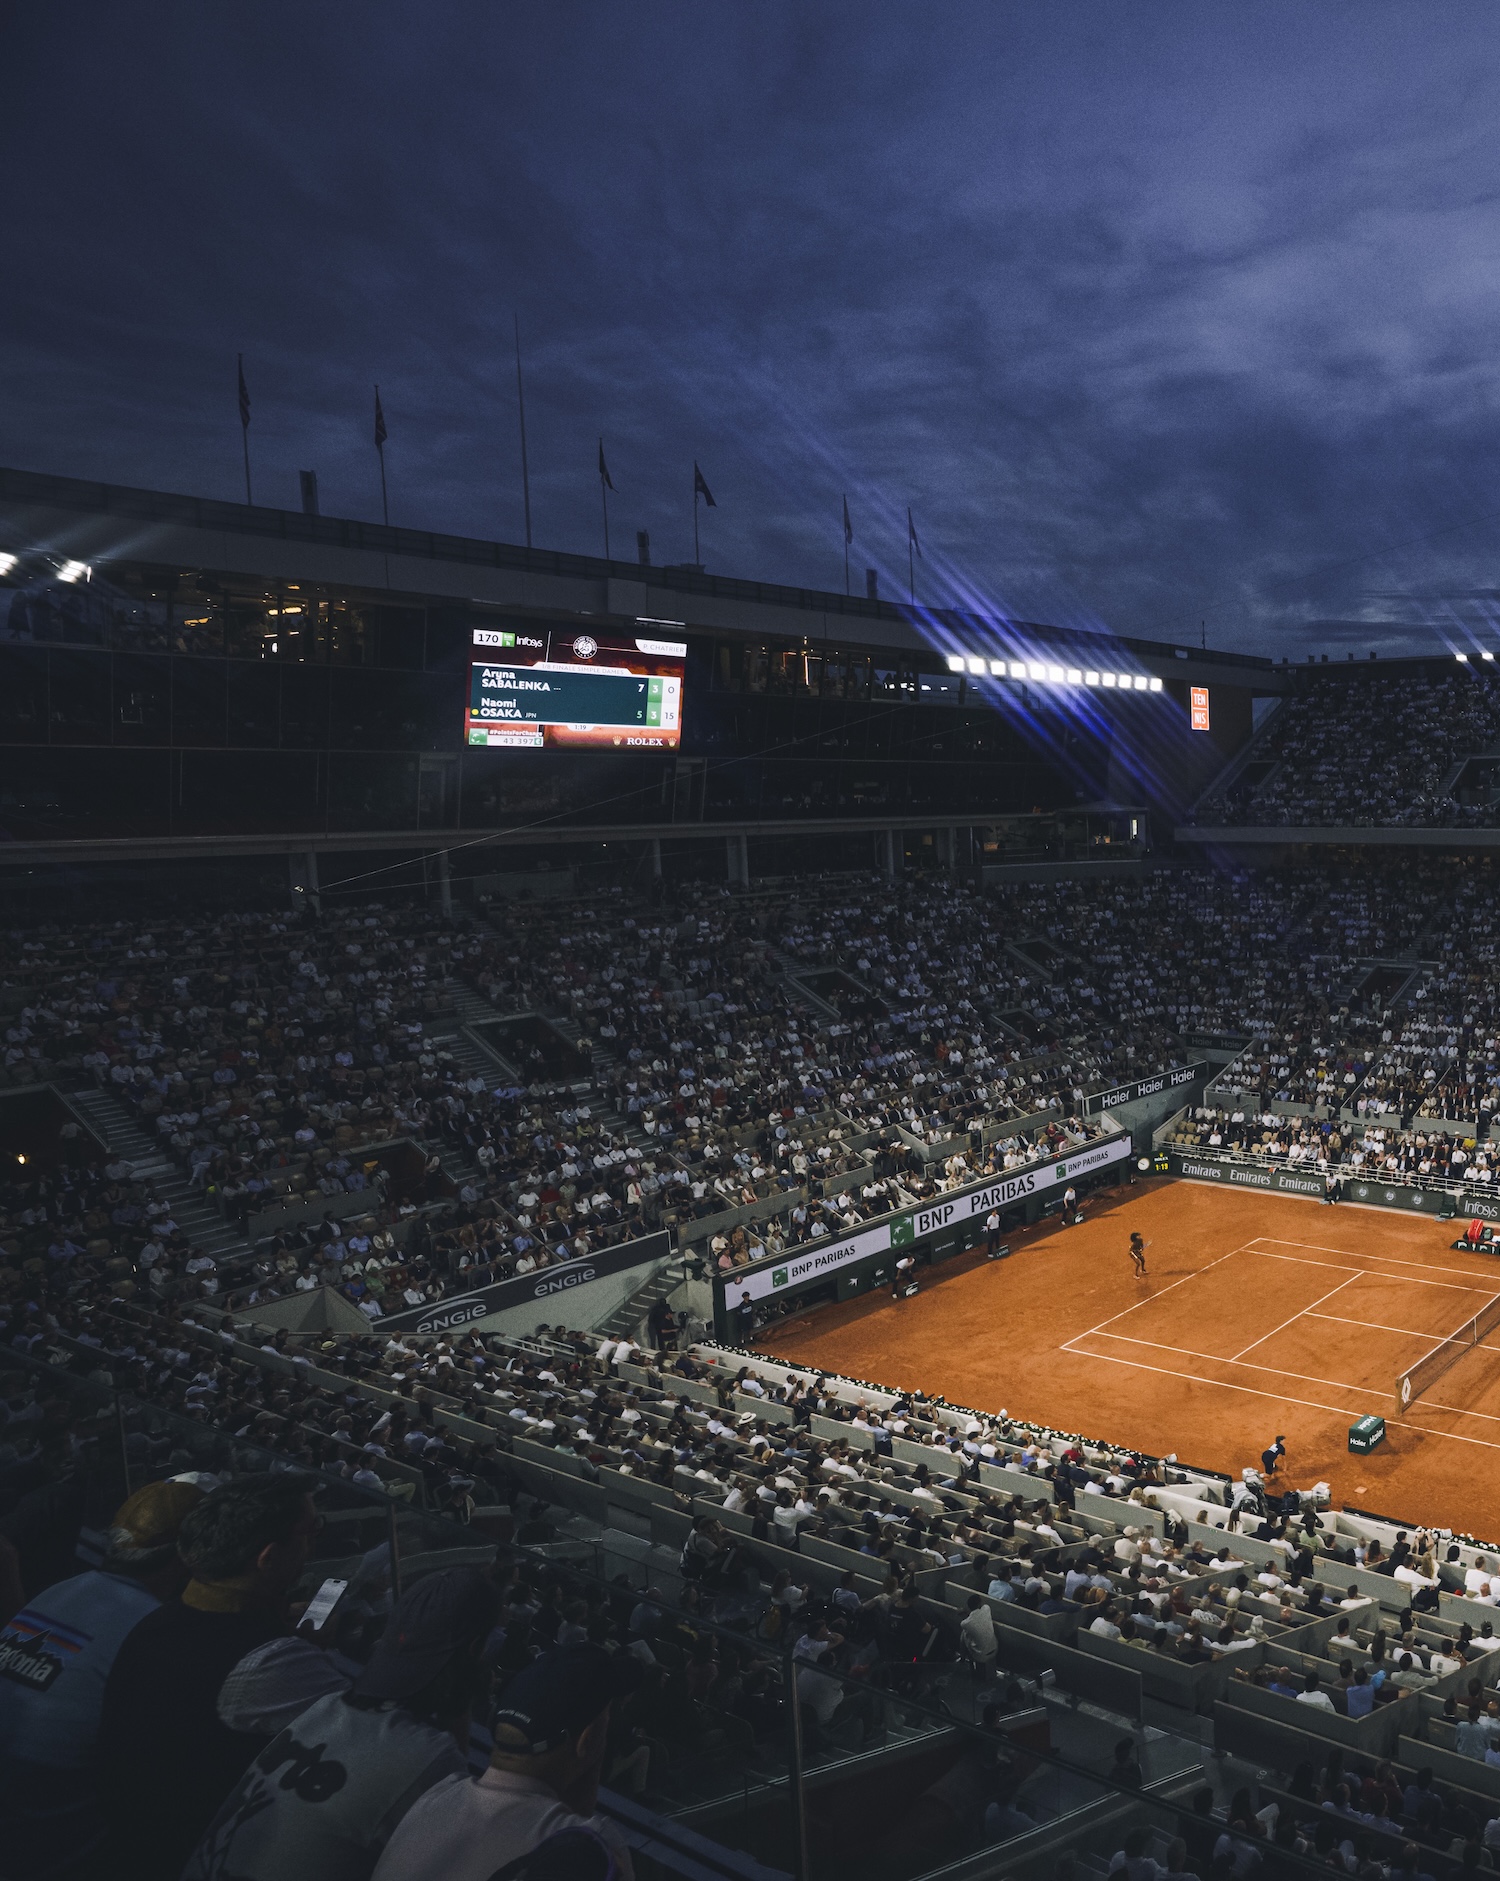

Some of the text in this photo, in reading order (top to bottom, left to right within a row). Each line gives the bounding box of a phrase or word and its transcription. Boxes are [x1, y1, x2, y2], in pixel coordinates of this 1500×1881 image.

[478, 633, 499, 643] 170
[516, 635, 543, 648] Infosys
[650, 644, 684, 653] CHATRIER
[482, 668, 516, 680] Aryna
[552, 664, 576, 672] FINALE
[577, 666, 601, 674] SIMPLE
[482, 678, 550, 692] SABALENKA
[638, 684, 645, 692] 7
[652, 684, 659, 693] 3
[481, 697, 516, 708] Naomi
[1193, 693, 1206, 706] TEN
[480, 708, 522, 718] OSAKA
[636, 710, 674, 720] 5 3 15
[1194, 712, 1206, 724] NIS
[626, 737, 664, 746] ROLEX
[1191, 1037, 1243, 1049] Haier Haier
[1102, 1069, 1196, 1109] Haier Haier Haier
[1067, 1150, 1109, 1173] BNP PARIBAS
[1181, 1162, 1321, 1193] Emirates Emirates Emirates
[919, 1174, 1035, 1233] BNP PARIBAS
[1464, 1199, 1499, 1218] Infosys
[791, 1245, 856, 1278] BNP PARIBAS
[1350, 1437, 1367, 1447] Haier
[0, 1645, 55, 1683] agonia
